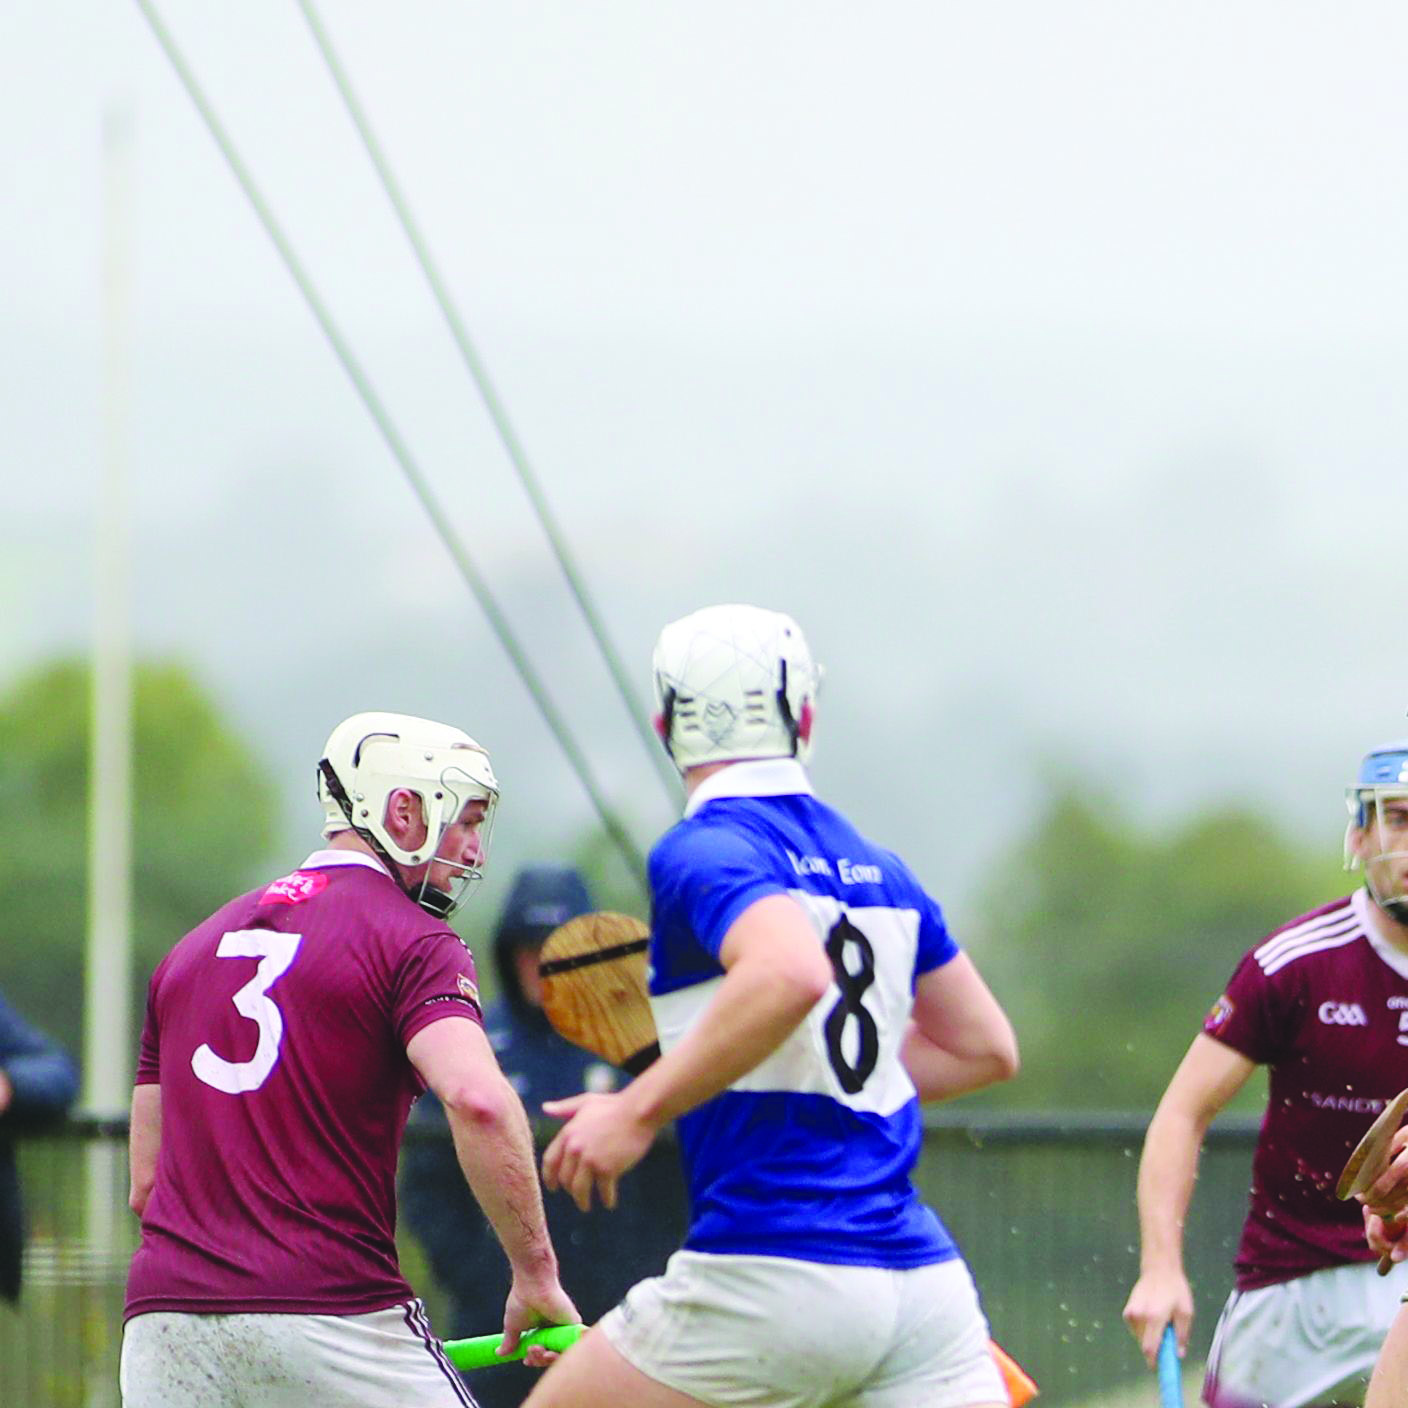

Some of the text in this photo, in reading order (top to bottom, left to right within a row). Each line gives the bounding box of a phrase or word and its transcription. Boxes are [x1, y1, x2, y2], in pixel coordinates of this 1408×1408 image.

[190, 928, 302, 1095] 3
[824, 912, 879, 1095] 8
[1318, 1001, 1367, 1026] GAA
